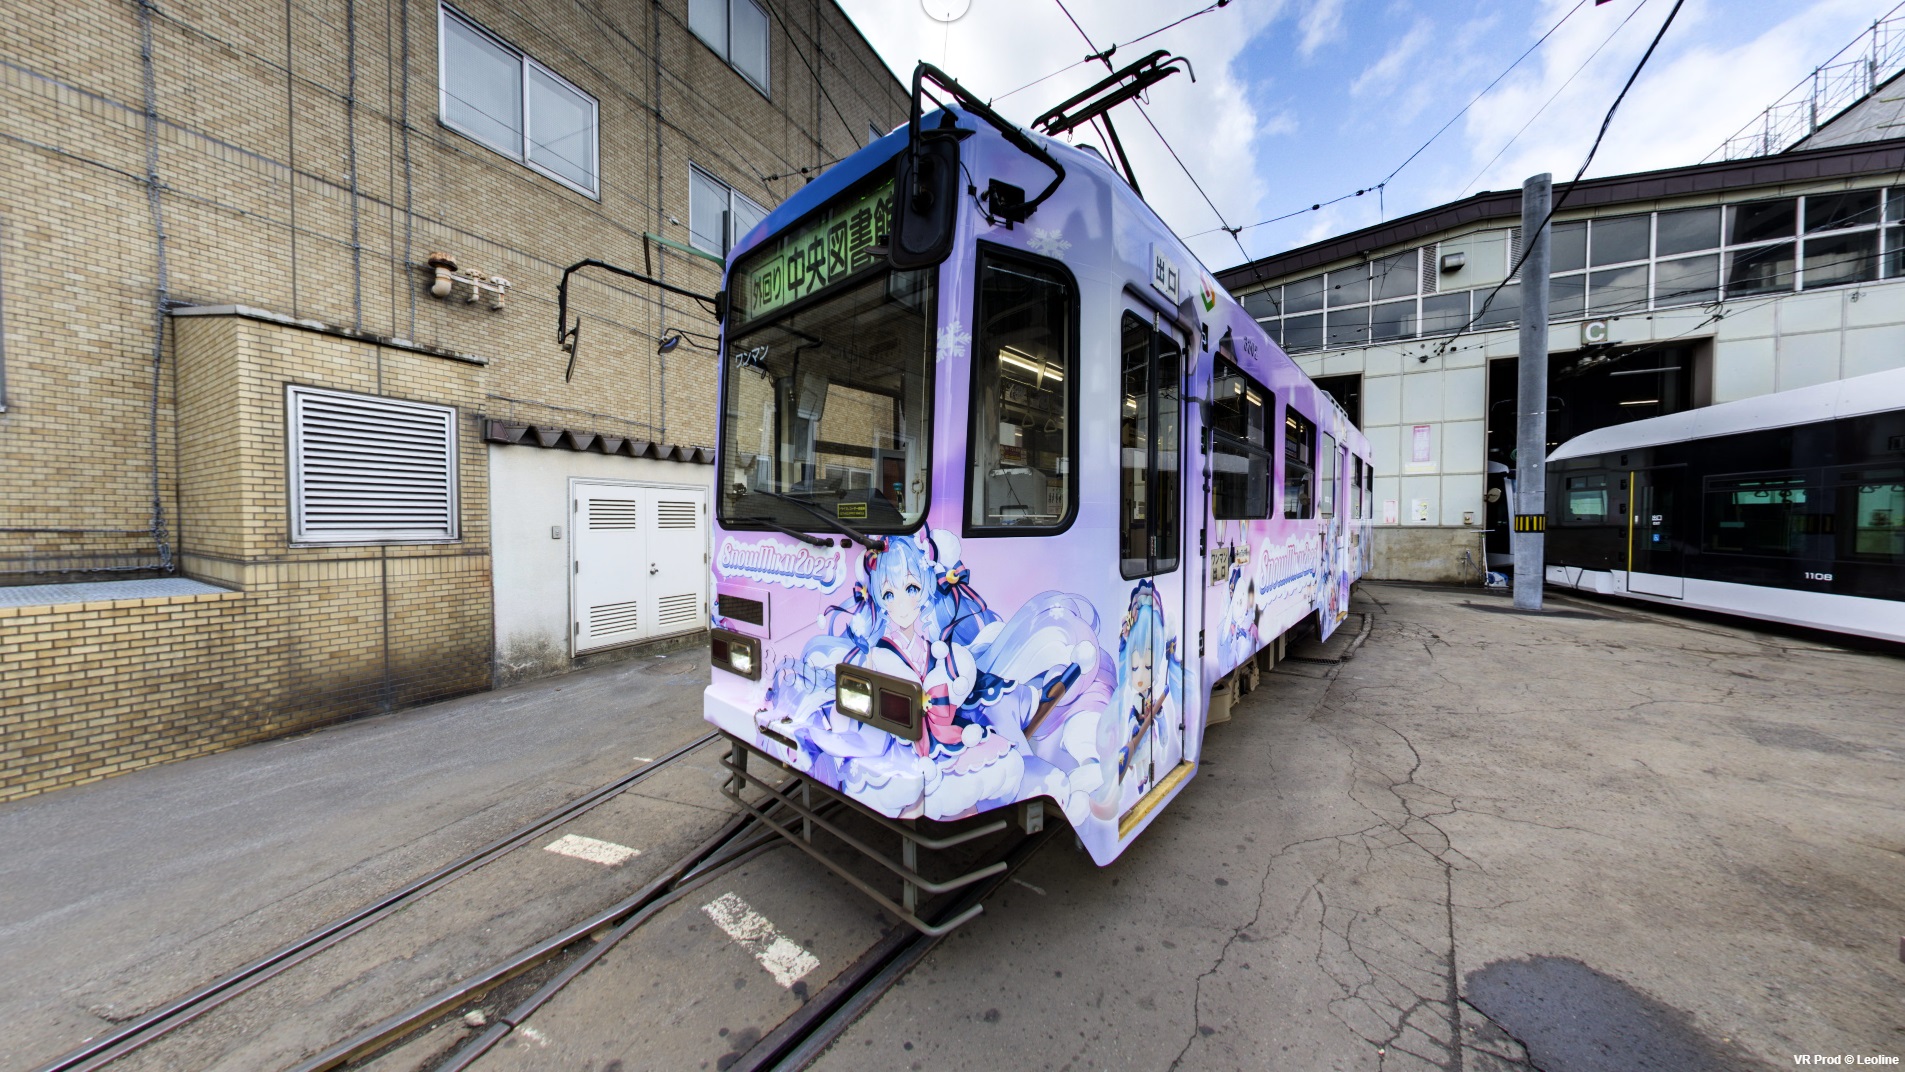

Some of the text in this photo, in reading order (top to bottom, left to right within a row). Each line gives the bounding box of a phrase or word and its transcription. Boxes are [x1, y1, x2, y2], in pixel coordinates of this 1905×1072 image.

[1156, 255, 1176, 295] 出口
[753, 266, 783, 310] 外回り
[1585, 321, 1605, 342] C
[735, 345, 769, 368] ワンマン
[1211, 552, 1228, 565] ワンマン
[1804, 572, 1833, 581] 1108
